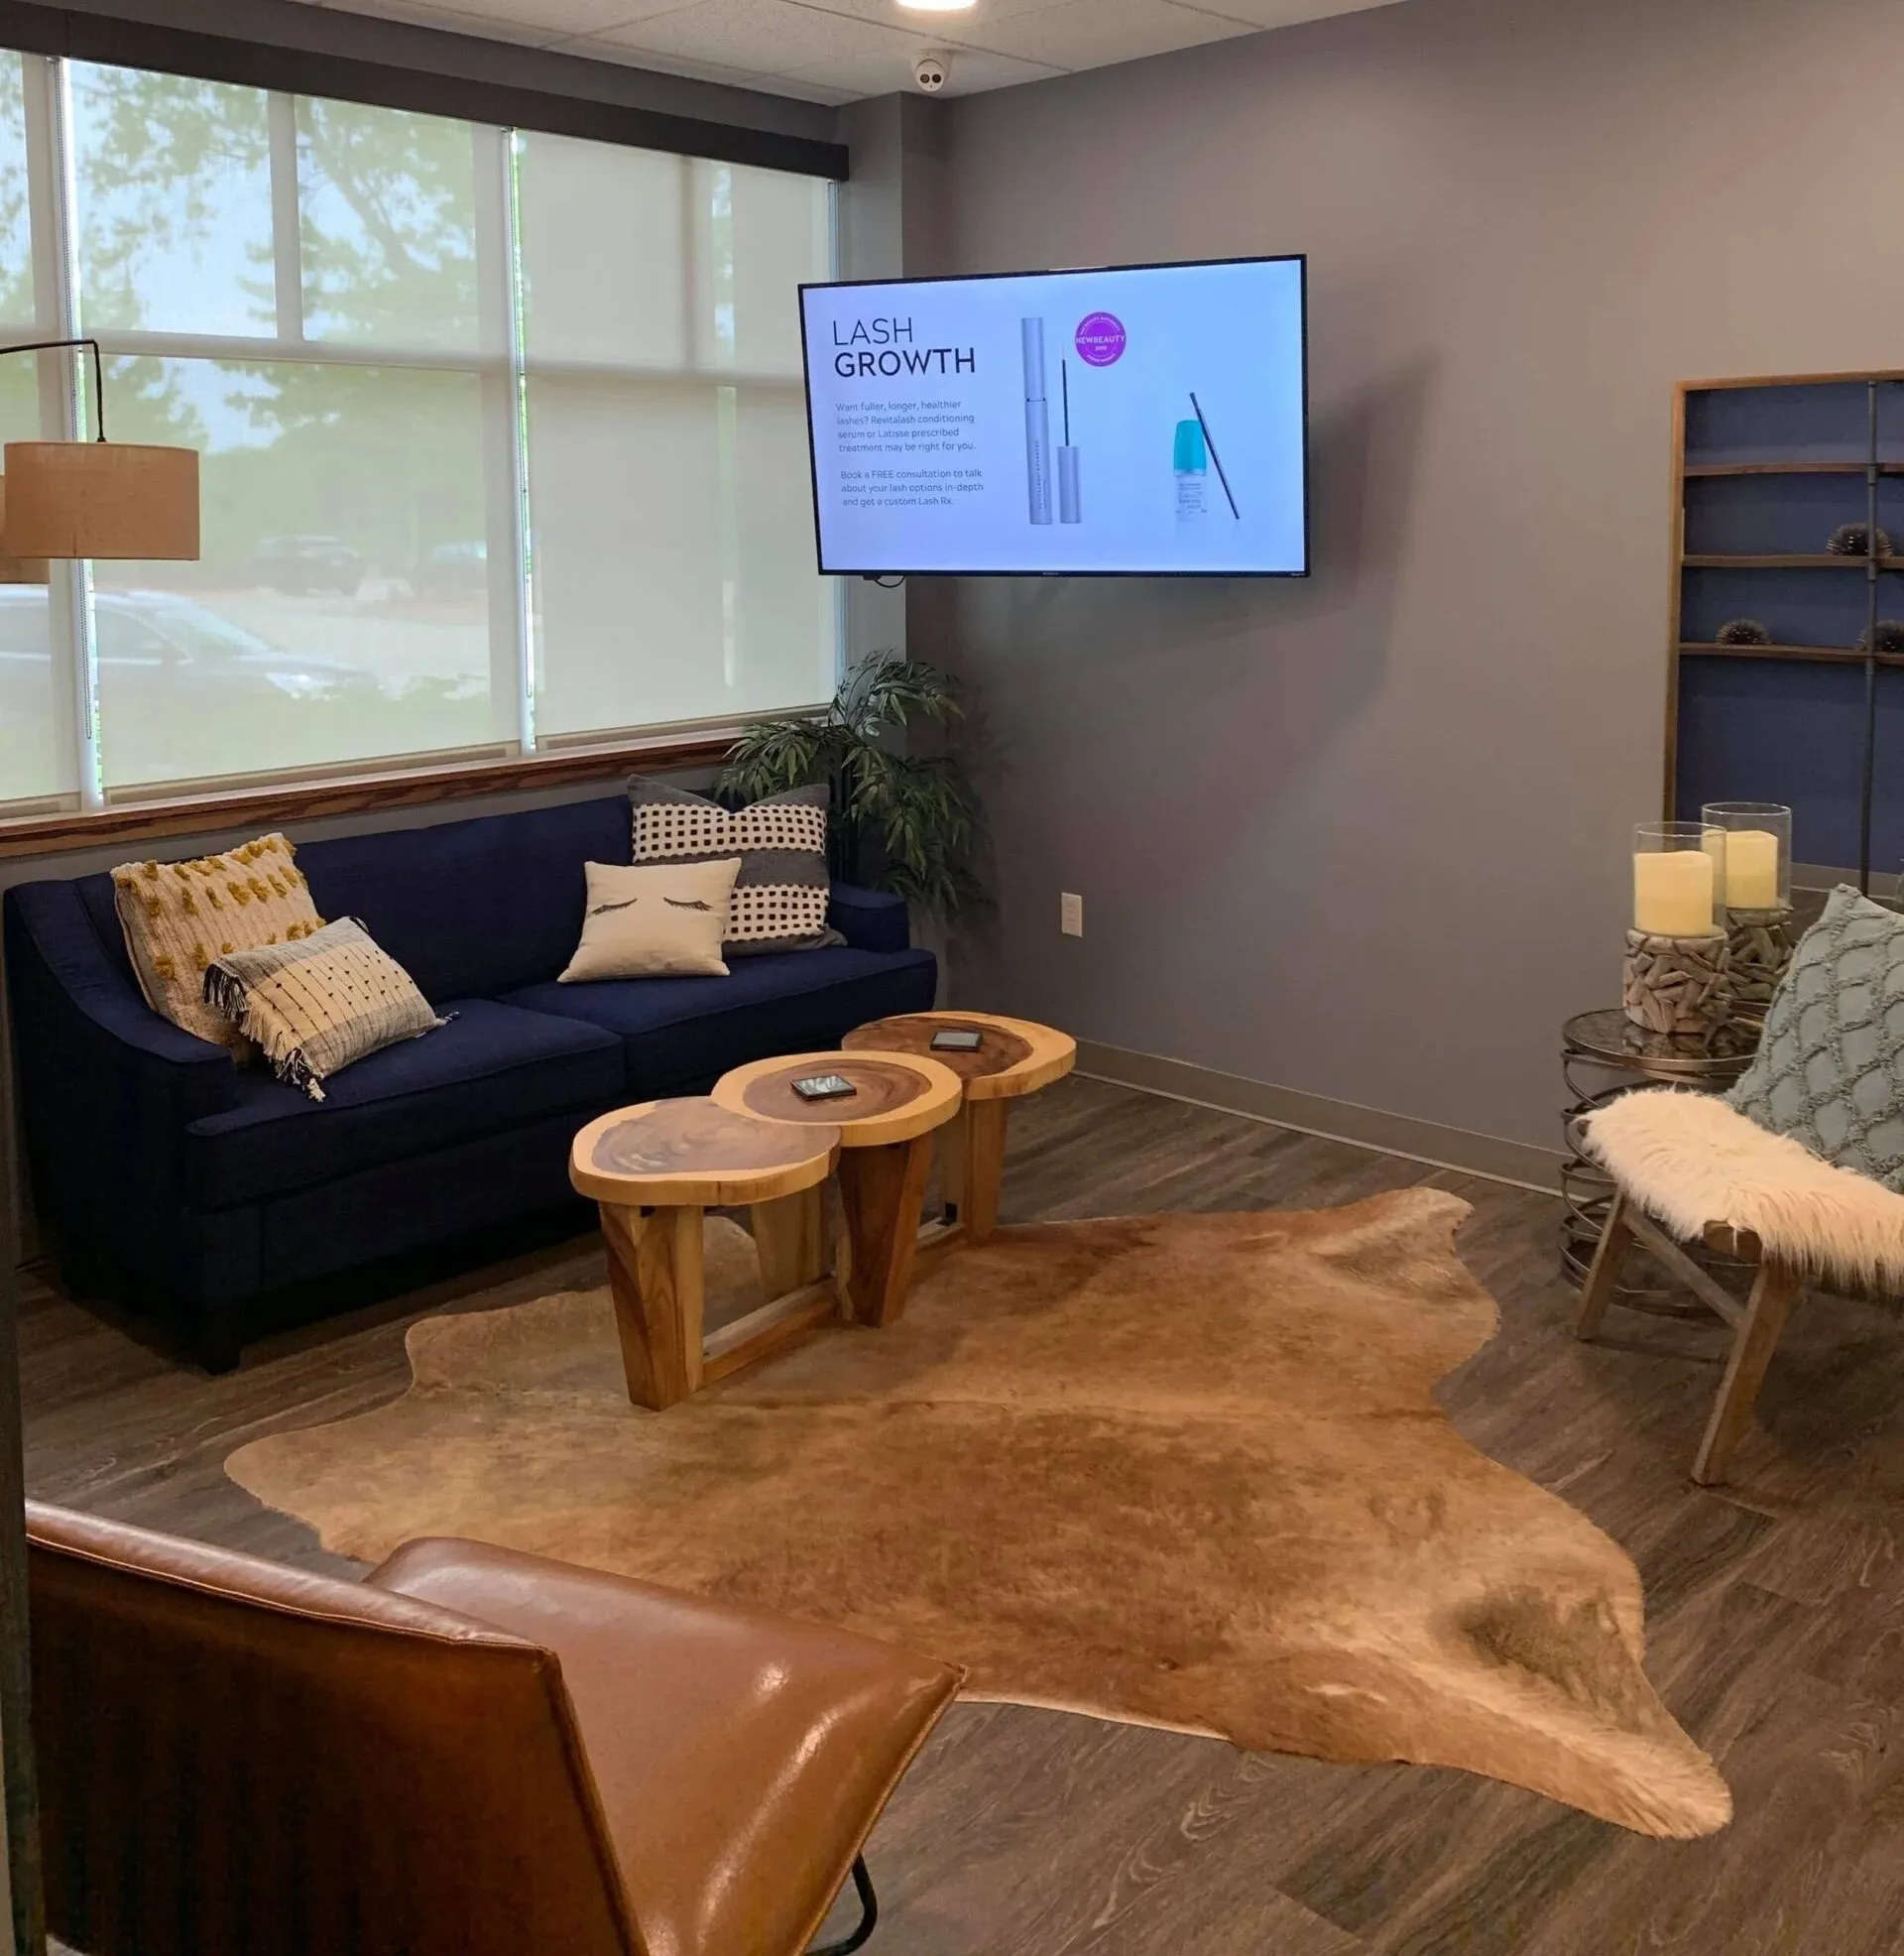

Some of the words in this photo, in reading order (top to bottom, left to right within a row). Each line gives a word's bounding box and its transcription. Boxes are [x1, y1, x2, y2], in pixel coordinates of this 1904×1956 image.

[833, 316, 912, 345] LASH
[1076, 334, 1126, 344] NEWBEAUTY
[834, 347, 976, 378] GROWTH
[835, 403, 859, 412] Want
[861, 402, 887, 412] fuller,
[889, 401, 919, 413] longer,
[921, 400, 962, 410] healthier
[837, 416, 869, 426] lashes?
[871, 415, 915, 425] Revitalash
[917, 414, 975, 424] conditioning
[879, 429, 909, 438] Latisse
[911, 428, 960, 439] prescribed
[839, 443, 883, 452] treatment
[885, 443, 903, 452] may
[918, 441, 940, 452] right
[942, 441, 955, 450] for
[957, 442, 976, 452] you.
[841, 470, 862, 479] Book
[896, 469, 951, 478] consultation
[841, 484, 867, 493] about
[869, 485, 888, 494] your
[909, 484, 943, 493] options
[945, 483, 984, 492] in-depth
[843, 497, 858, 506] and
[860, 498, 875, 508] get
[885, 497, 917, 506] custom
